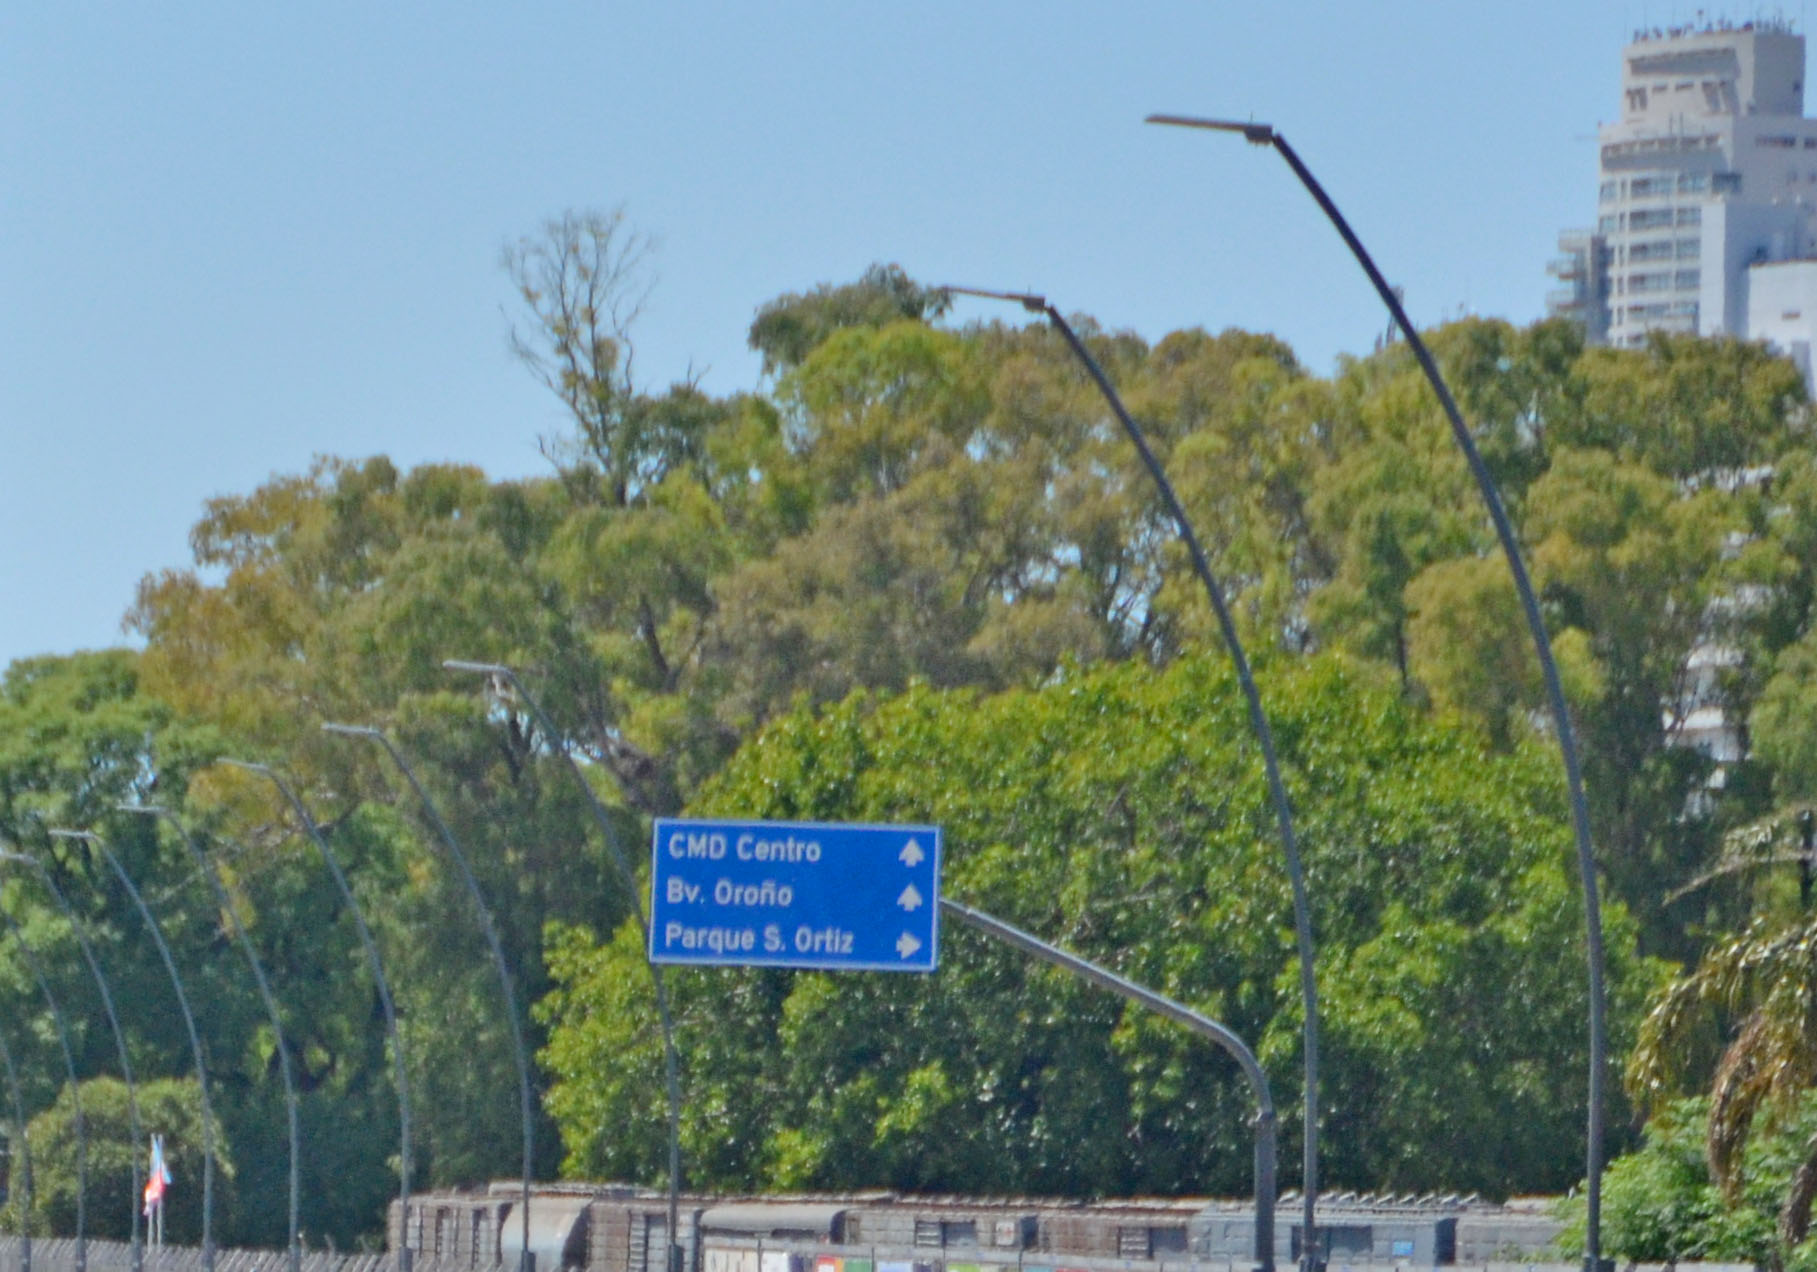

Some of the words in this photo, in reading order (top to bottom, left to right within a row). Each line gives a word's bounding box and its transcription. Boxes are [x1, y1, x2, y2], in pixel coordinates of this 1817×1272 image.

[668, 832, 726, 859] CMD
[736, 835, 821, 862] Centro
[666, 876, 705, 905] Bv.
[714, 878, 793, 906] Oroño
[665, 921, 756, 954] Parque
[763, 923, 786, 952] S.
[794, 925, 854, 955] Ortiz
